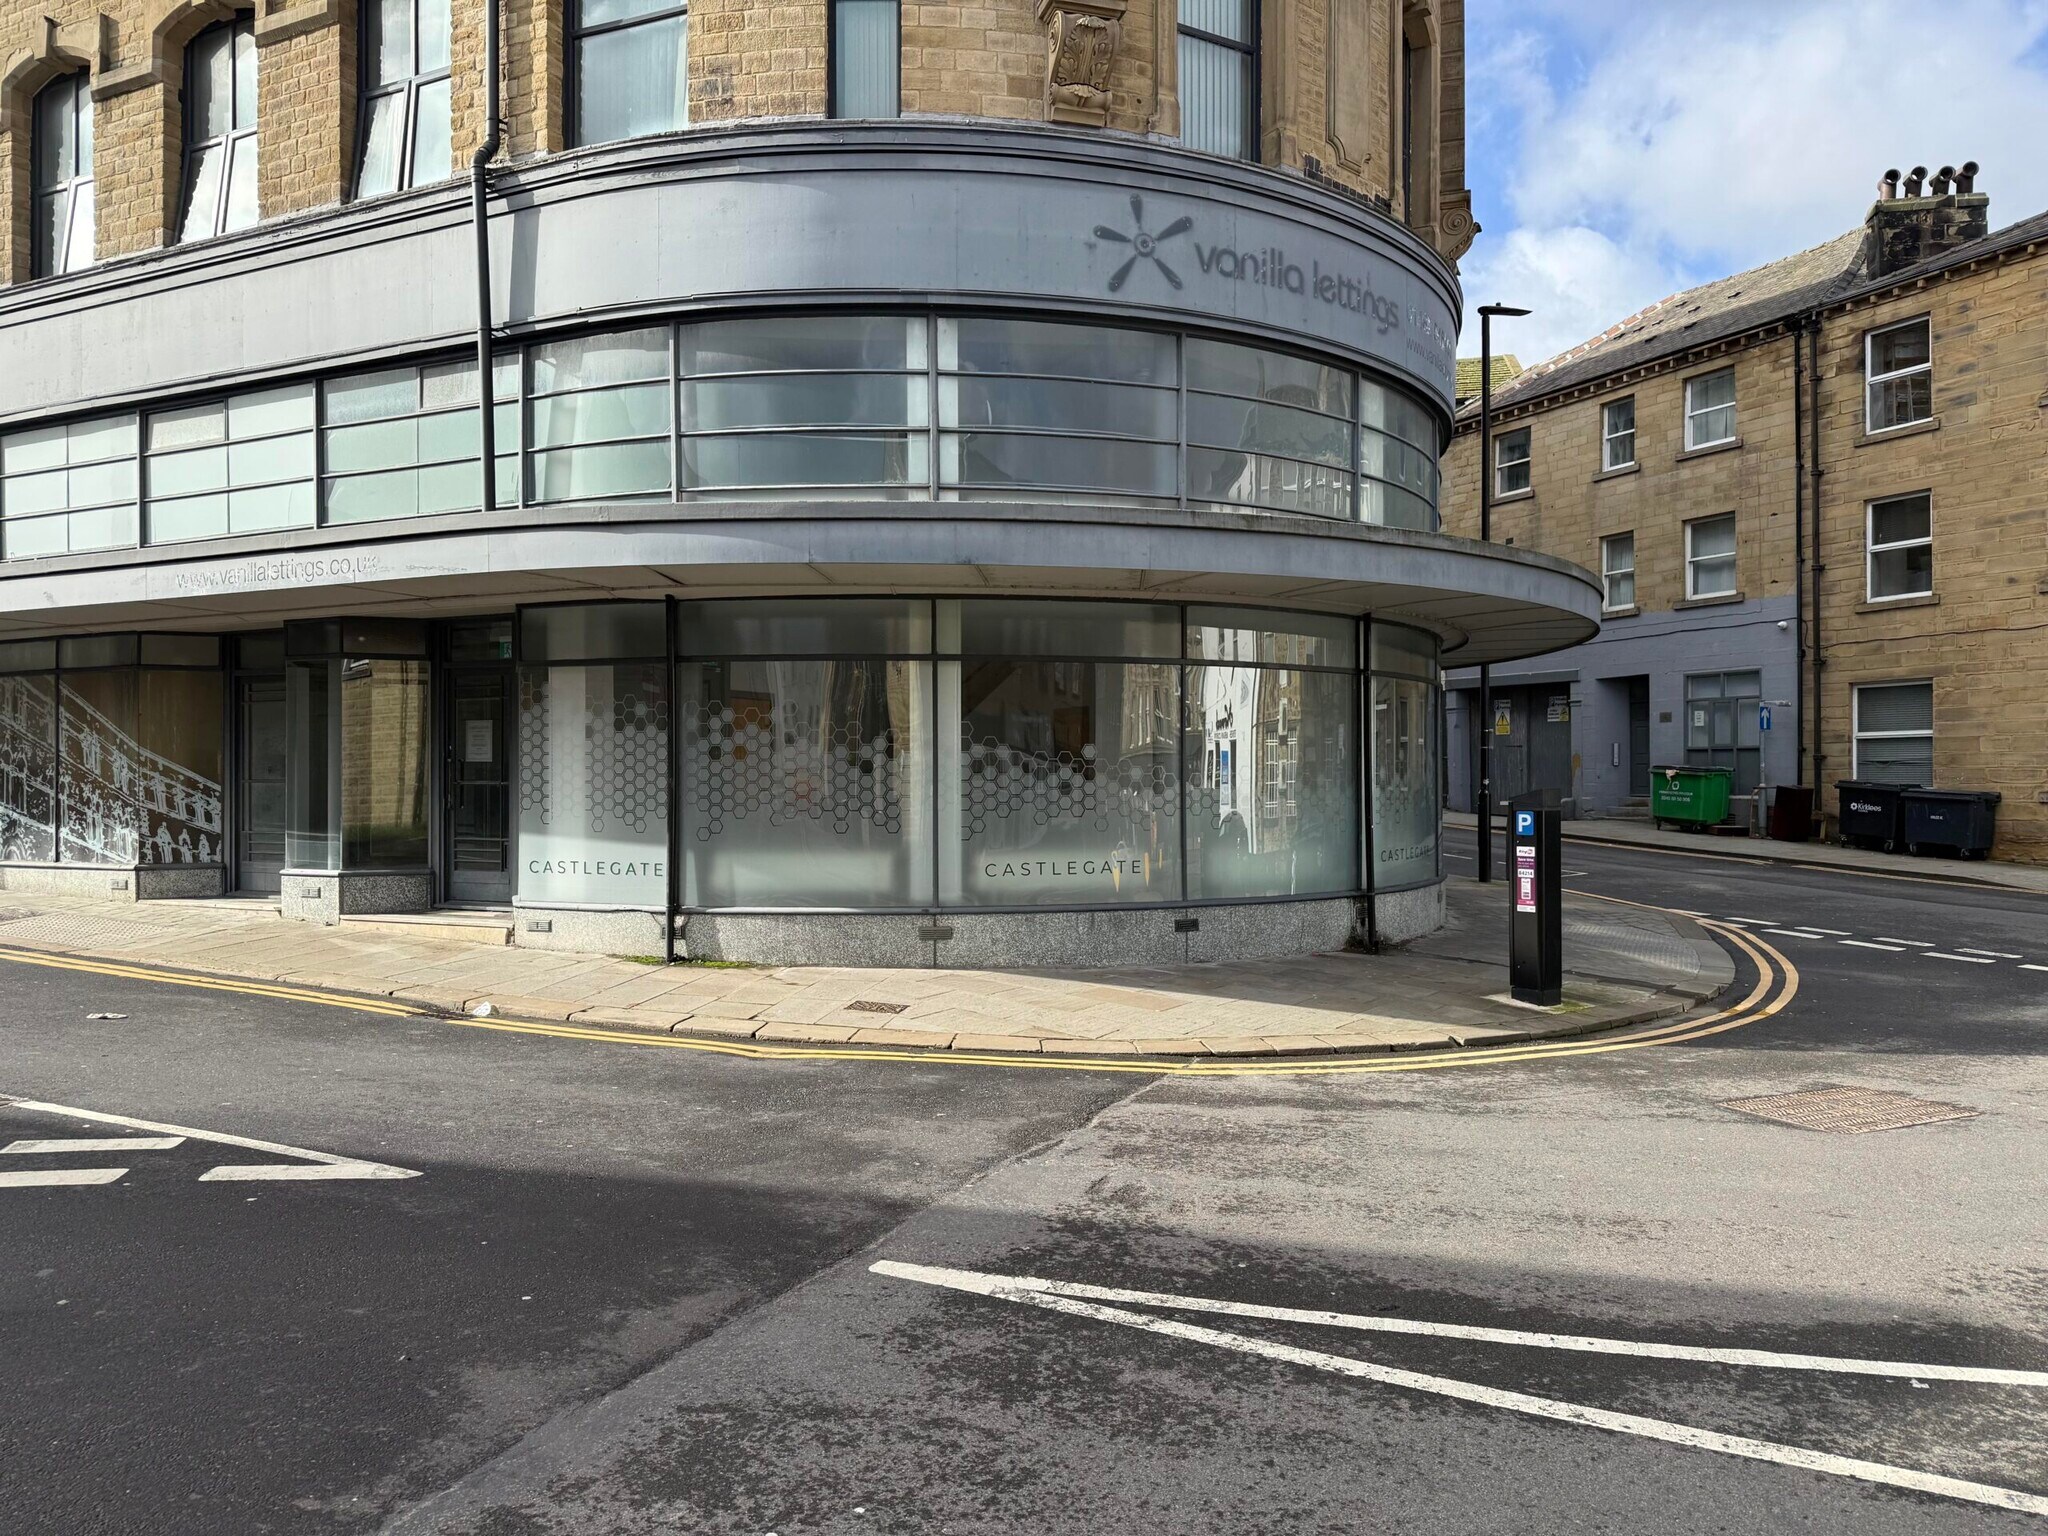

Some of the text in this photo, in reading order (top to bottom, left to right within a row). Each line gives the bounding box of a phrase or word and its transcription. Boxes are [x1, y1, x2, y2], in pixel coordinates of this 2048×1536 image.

[1195, 242, 1304, 295] vanilla
[1313, 259, 1399, 334] lettings
[1518, 813, 1532, 832] P
[1380, 845, 1431, 863] CASTLEGATE
[528, 860, 664, 877] CASTLEGATE
[985, 859, 1142, 878] CASTLEGATE
